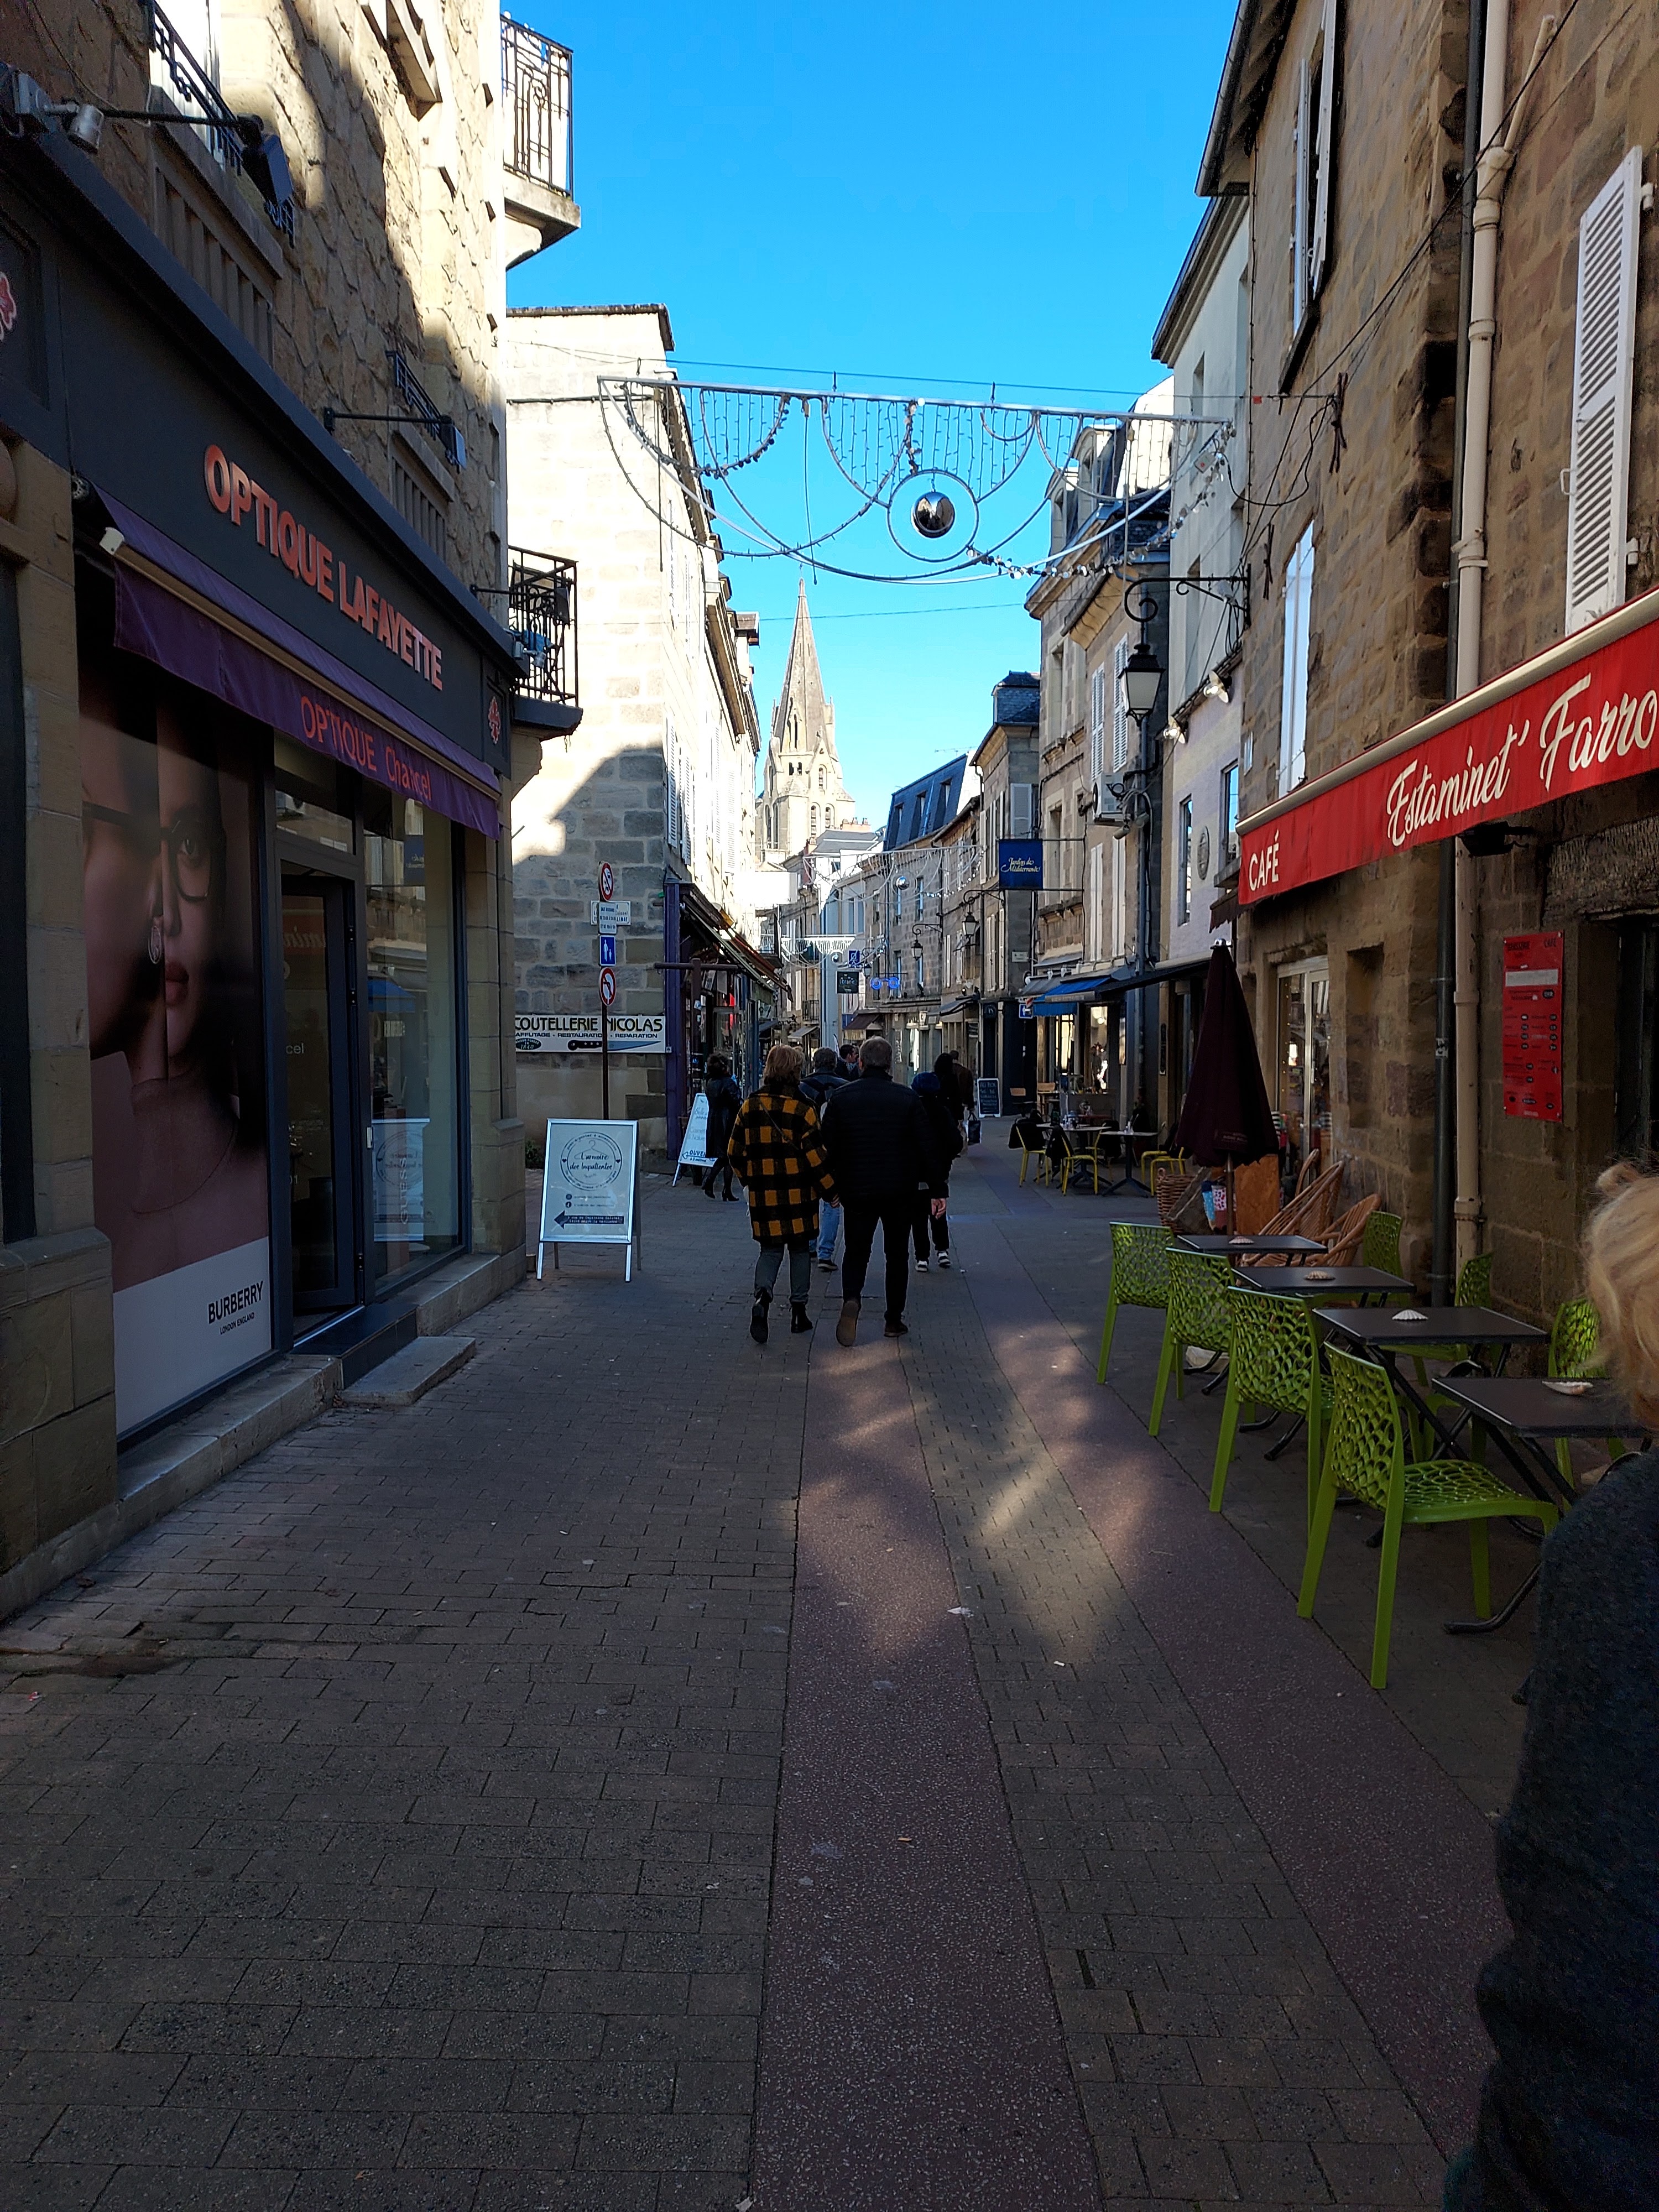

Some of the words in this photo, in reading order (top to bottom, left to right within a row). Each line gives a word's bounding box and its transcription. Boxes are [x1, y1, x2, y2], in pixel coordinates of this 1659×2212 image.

[204, 444, 334, 603] OPTIQUE
[338, 560, 442, 691] LAFAYETTE
[300, 695, 377, 772] OPTIQUE
[385, 745, 432, 801] Chancel
[1540, 672, 1658, 792] Farro
[1248, 829, 1280, 892] CAFÉ
[515, 1017, 598, 1031] COUTELLERIE
[607, 1018, 663, 1032] NICOLAS
[570, 1162, 580, 1170] des
[581, 1162, 613, 1172] Impatientes
[580, 1152, 608, 1160] L'armoire
[208, 1280, 264, 1324] BURBERRY
[220, 1321, 237, 1335] LONDON
[237, 1312, 255, 1327] ENGLAND
